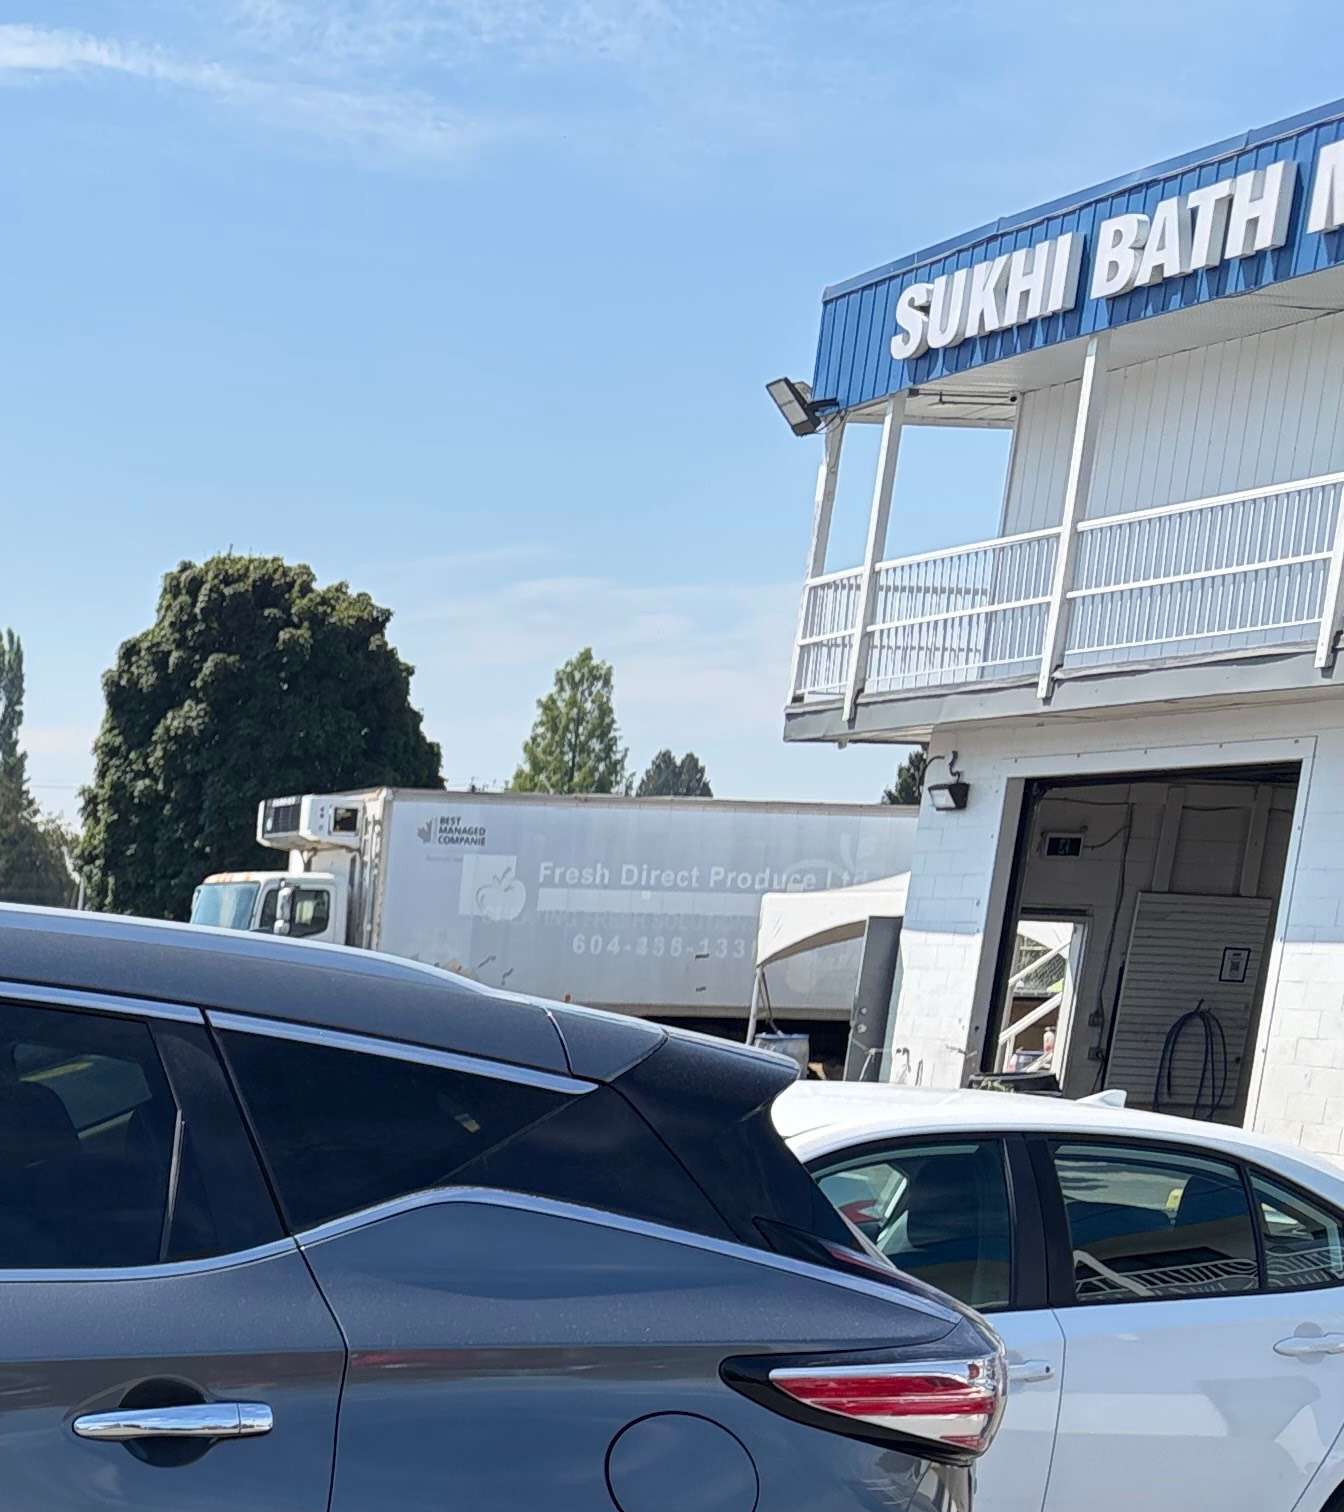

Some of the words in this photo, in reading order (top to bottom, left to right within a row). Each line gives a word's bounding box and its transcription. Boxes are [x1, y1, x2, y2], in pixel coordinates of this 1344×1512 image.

[890, 231, 1083, 360] SUKHI
[1090, 160, 1298, 299] BATH
[438, 825, 486, 837] MANAGED
[439, 815, 462, 826] BEST
[538, 861, 610, 885] Fresh
[620, 863, 700, 888] Direct
[709, 866, 816, 891] Produce
